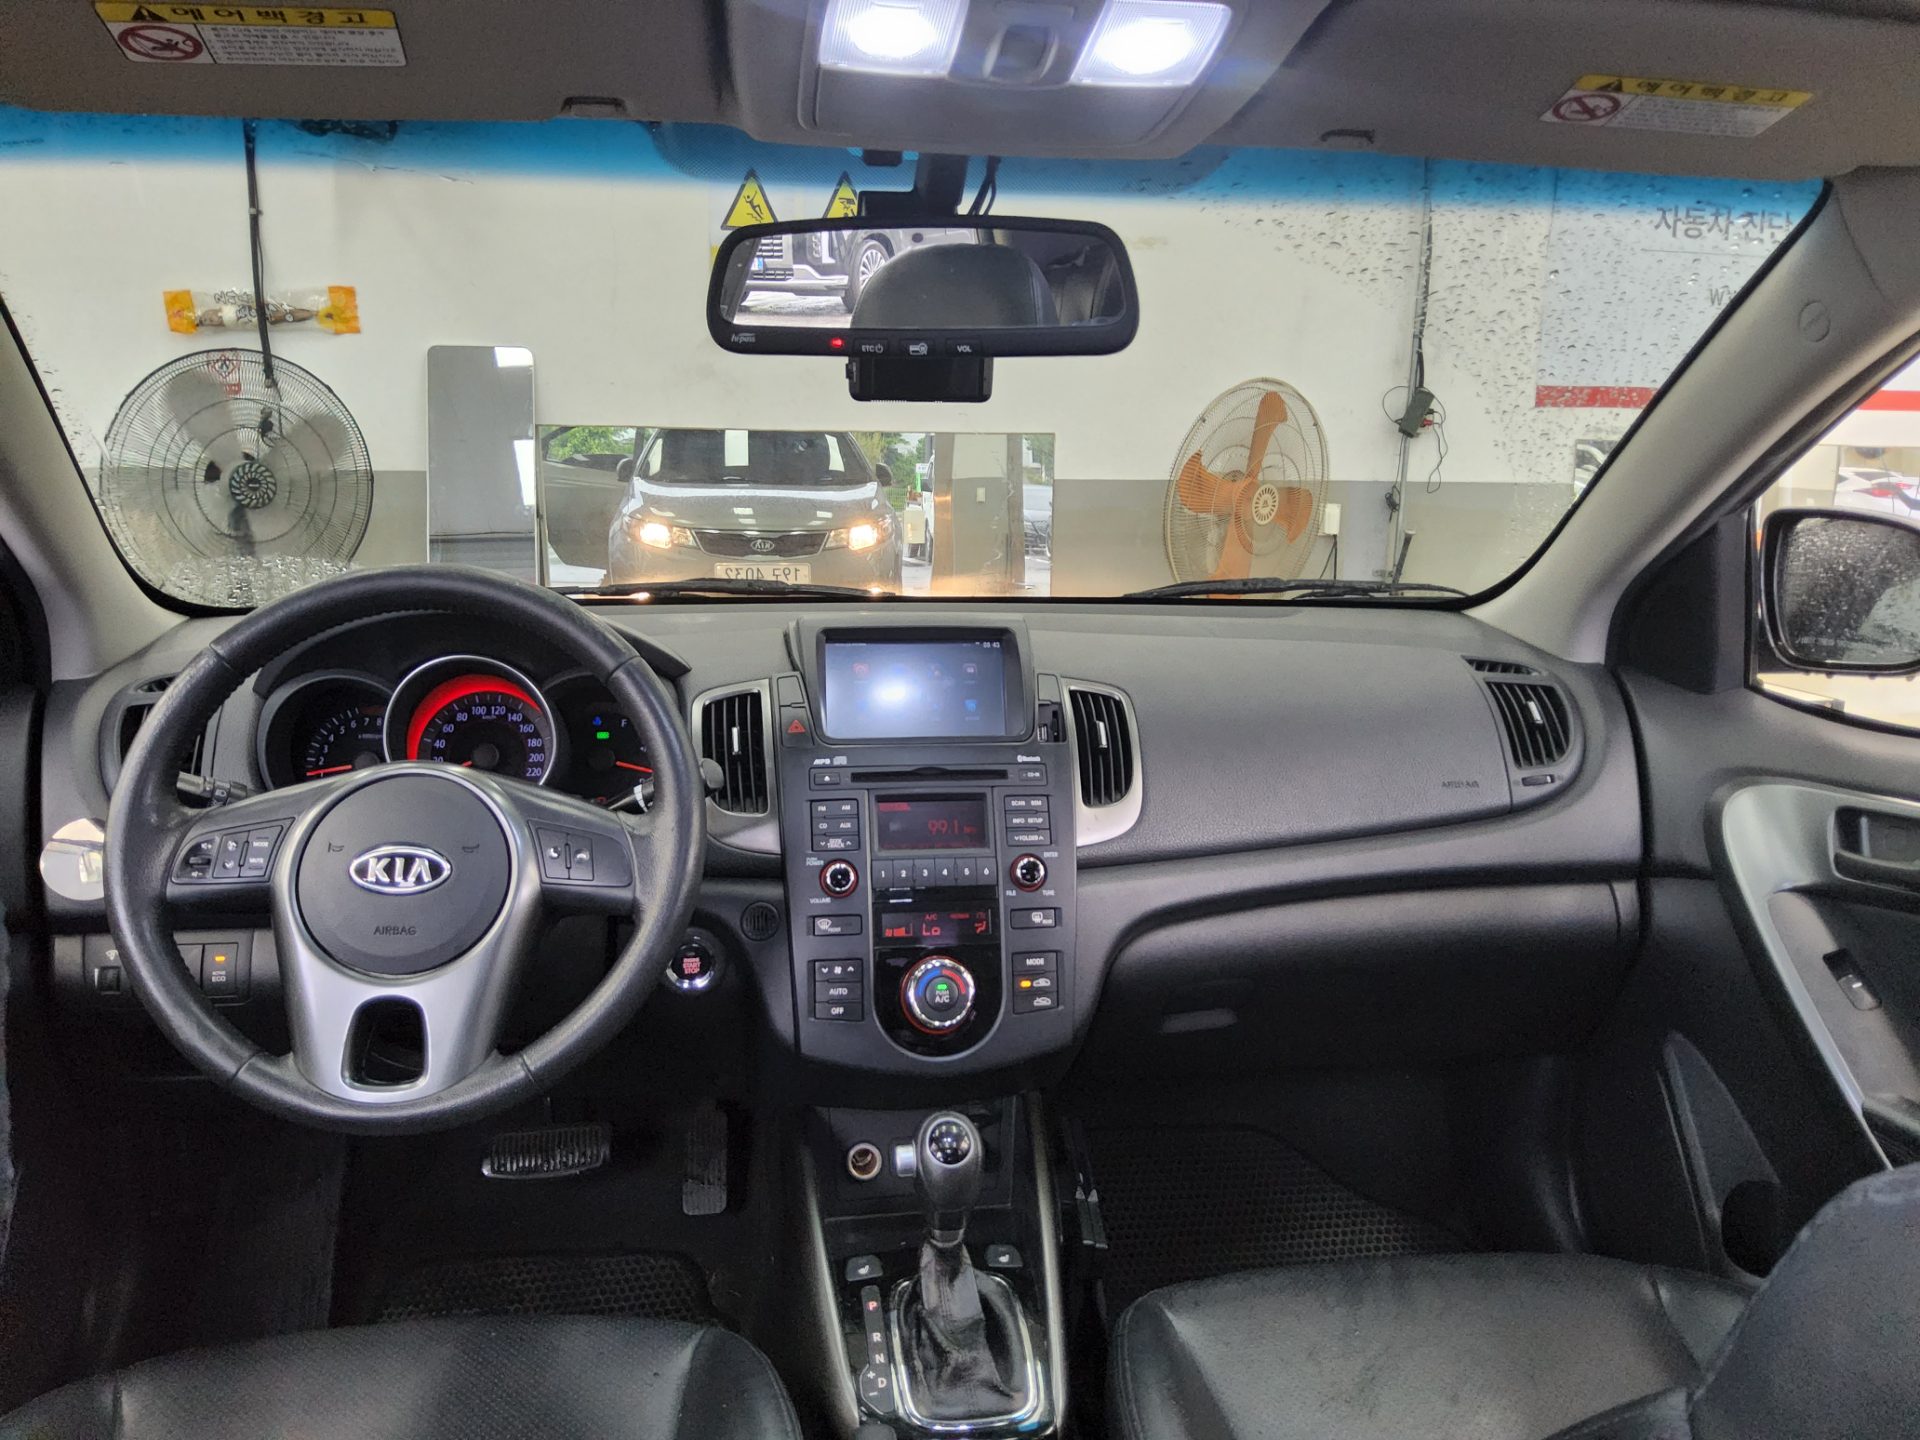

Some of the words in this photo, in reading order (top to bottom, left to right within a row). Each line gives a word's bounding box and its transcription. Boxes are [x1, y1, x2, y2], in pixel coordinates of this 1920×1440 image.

[1654, 205, 1733, 240] 자동차
[862, 345, 875, 353] ETC
[957, 345, 972, 353] VOL
[471, 706, 487, 715] 100
[491, 706, 506, 715] 120
[456, 712, 468, 721] 80
[508, 713, 522, 722] 140
[350, 720, 357, 728] 6
[364, 717, 370, 726] 7
[620, 719, 627, 728] F
[339, 726, 345, 735] 5
[442, 724, 454, 733] 60
[520, 724, 534, 733] 160
[328, 734, 334, 742] 4
[527, 738, 542, 747] 180
[434, 740, 446, 749] 40
[319, 757, 324, 765] 2
[529, 753, 544, 762] 200
[526, 767, 542, 777] 220
[365, 857, 433, 883] KIA
[900, 870, 907, 878] 2
[922, 869, 928, 877] 3
[942, 868, 948, 876] 4
[964, 867, 970, 875] 5
[983, 867, 990, 875] 6
[373, 926, 417, 935] AIRBAG
[1026, 958, 1044, 966] MODE
[935, 995, 950, 1003] A/C
[831, 1007, 844, 1015] OFF
[868, 1300, 878, 1311] P
[873, 1332, 882, 1342] R
[875, 1353, 885, 1364] N
[877, 1378, 887, 1388] D
